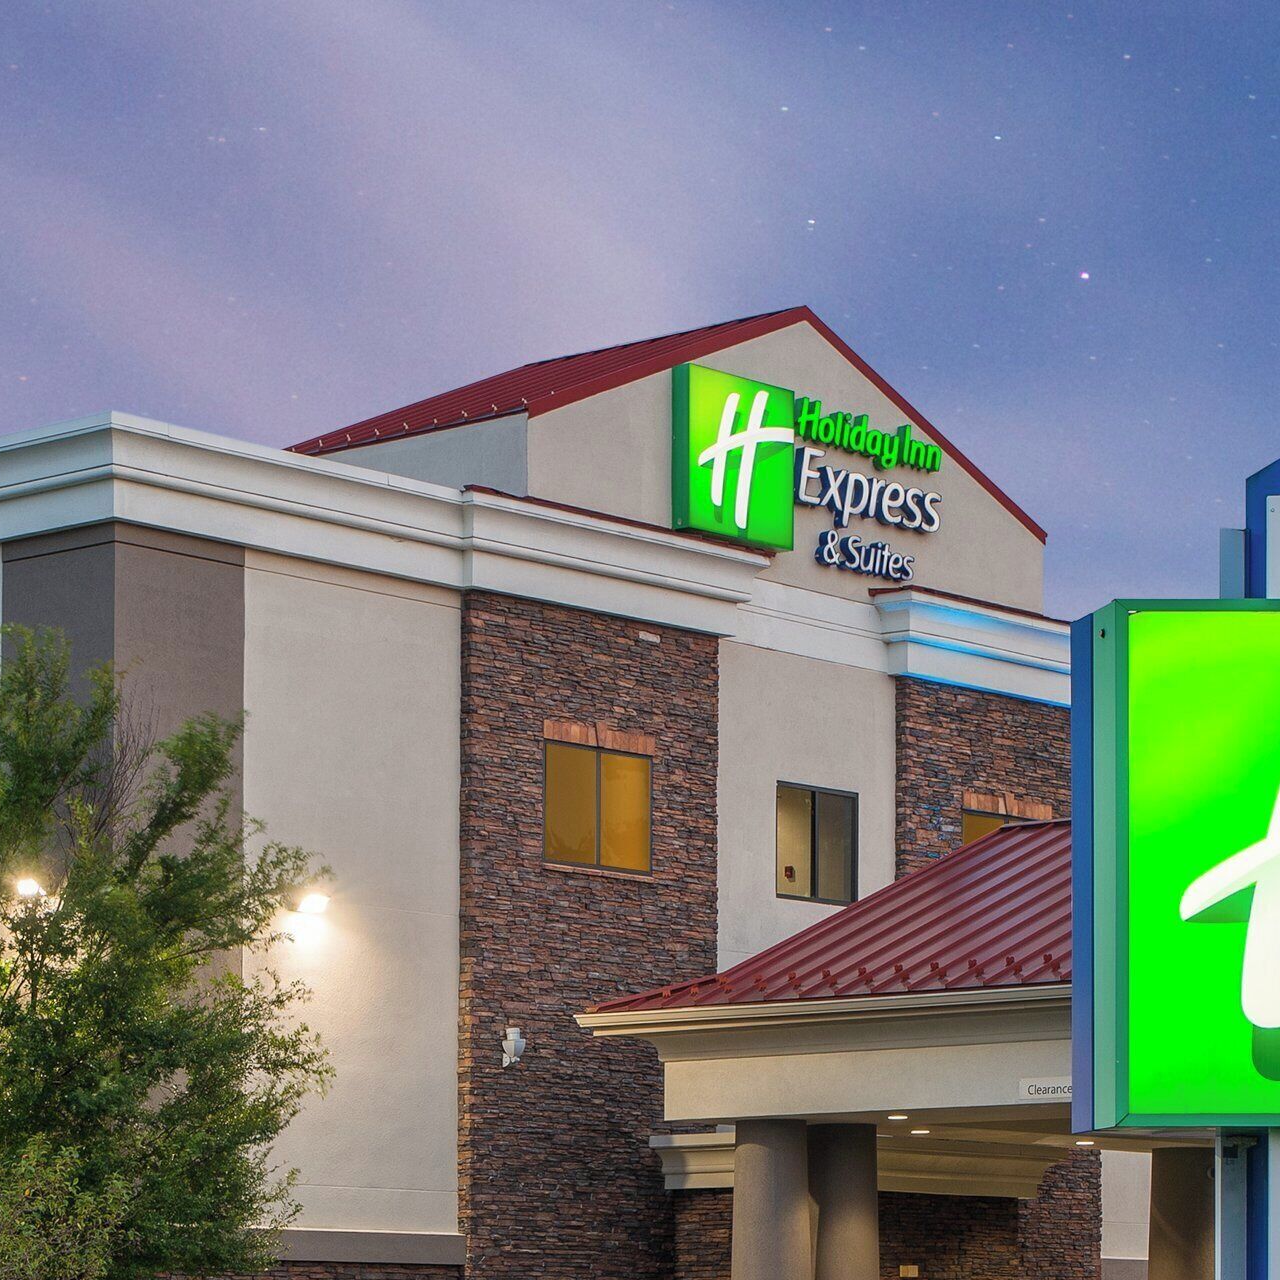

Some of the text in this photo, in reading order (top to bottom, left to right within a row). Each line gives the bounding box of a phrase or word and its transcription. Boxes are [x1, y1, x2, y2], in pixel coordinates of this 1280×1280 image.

[796, 398, 942, 472] Holiday Inn
[797, 447, 942, 533] Express
[822, 530, 915, 581] & Suites
[1027, 1084, 1072, 1095] Clearance
